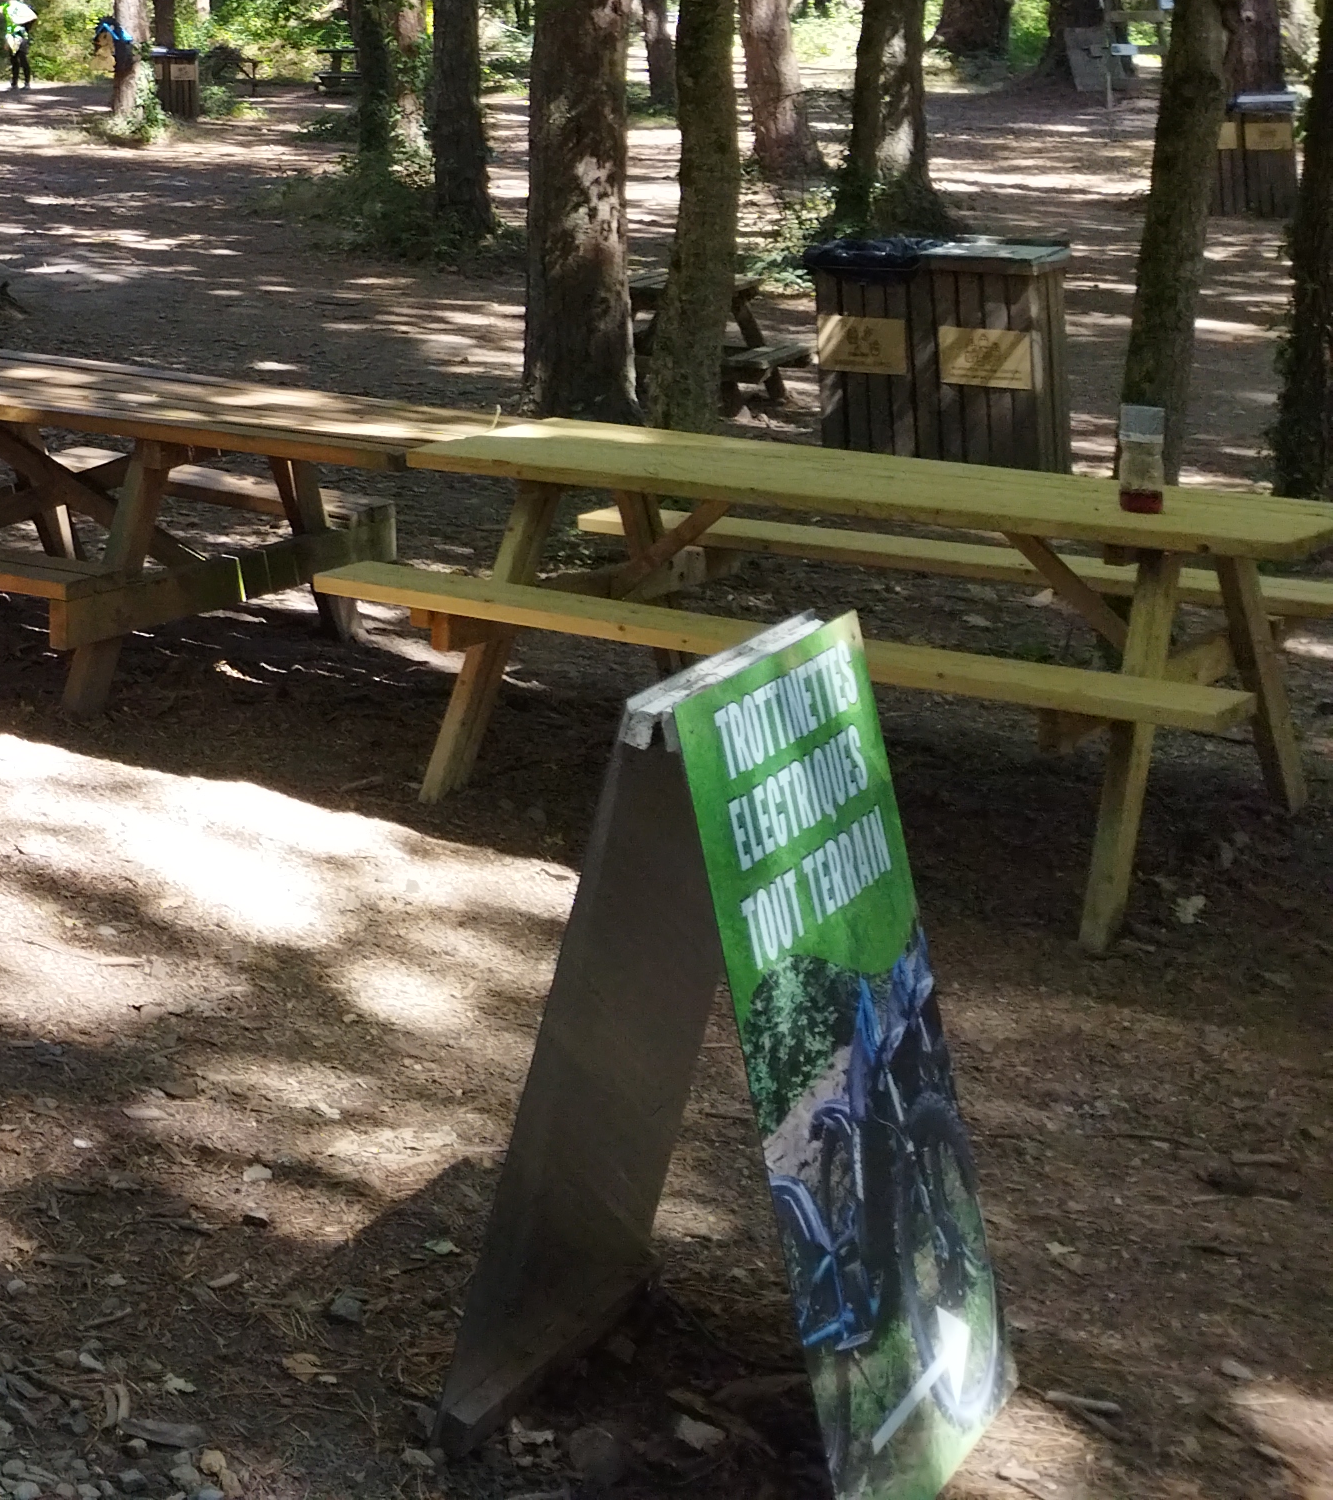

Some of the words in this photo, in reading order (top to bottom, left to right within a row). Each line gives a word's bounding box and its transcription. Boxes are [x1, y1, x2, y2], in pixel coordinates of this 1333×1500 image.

[713, 638, 859, 780] TROTTINETTES
[728, 724, 869, 872] ELECTRIQUES
[740, 867, 805, 971] TOUT
[802, 805, 892, 925] TERRAIN
